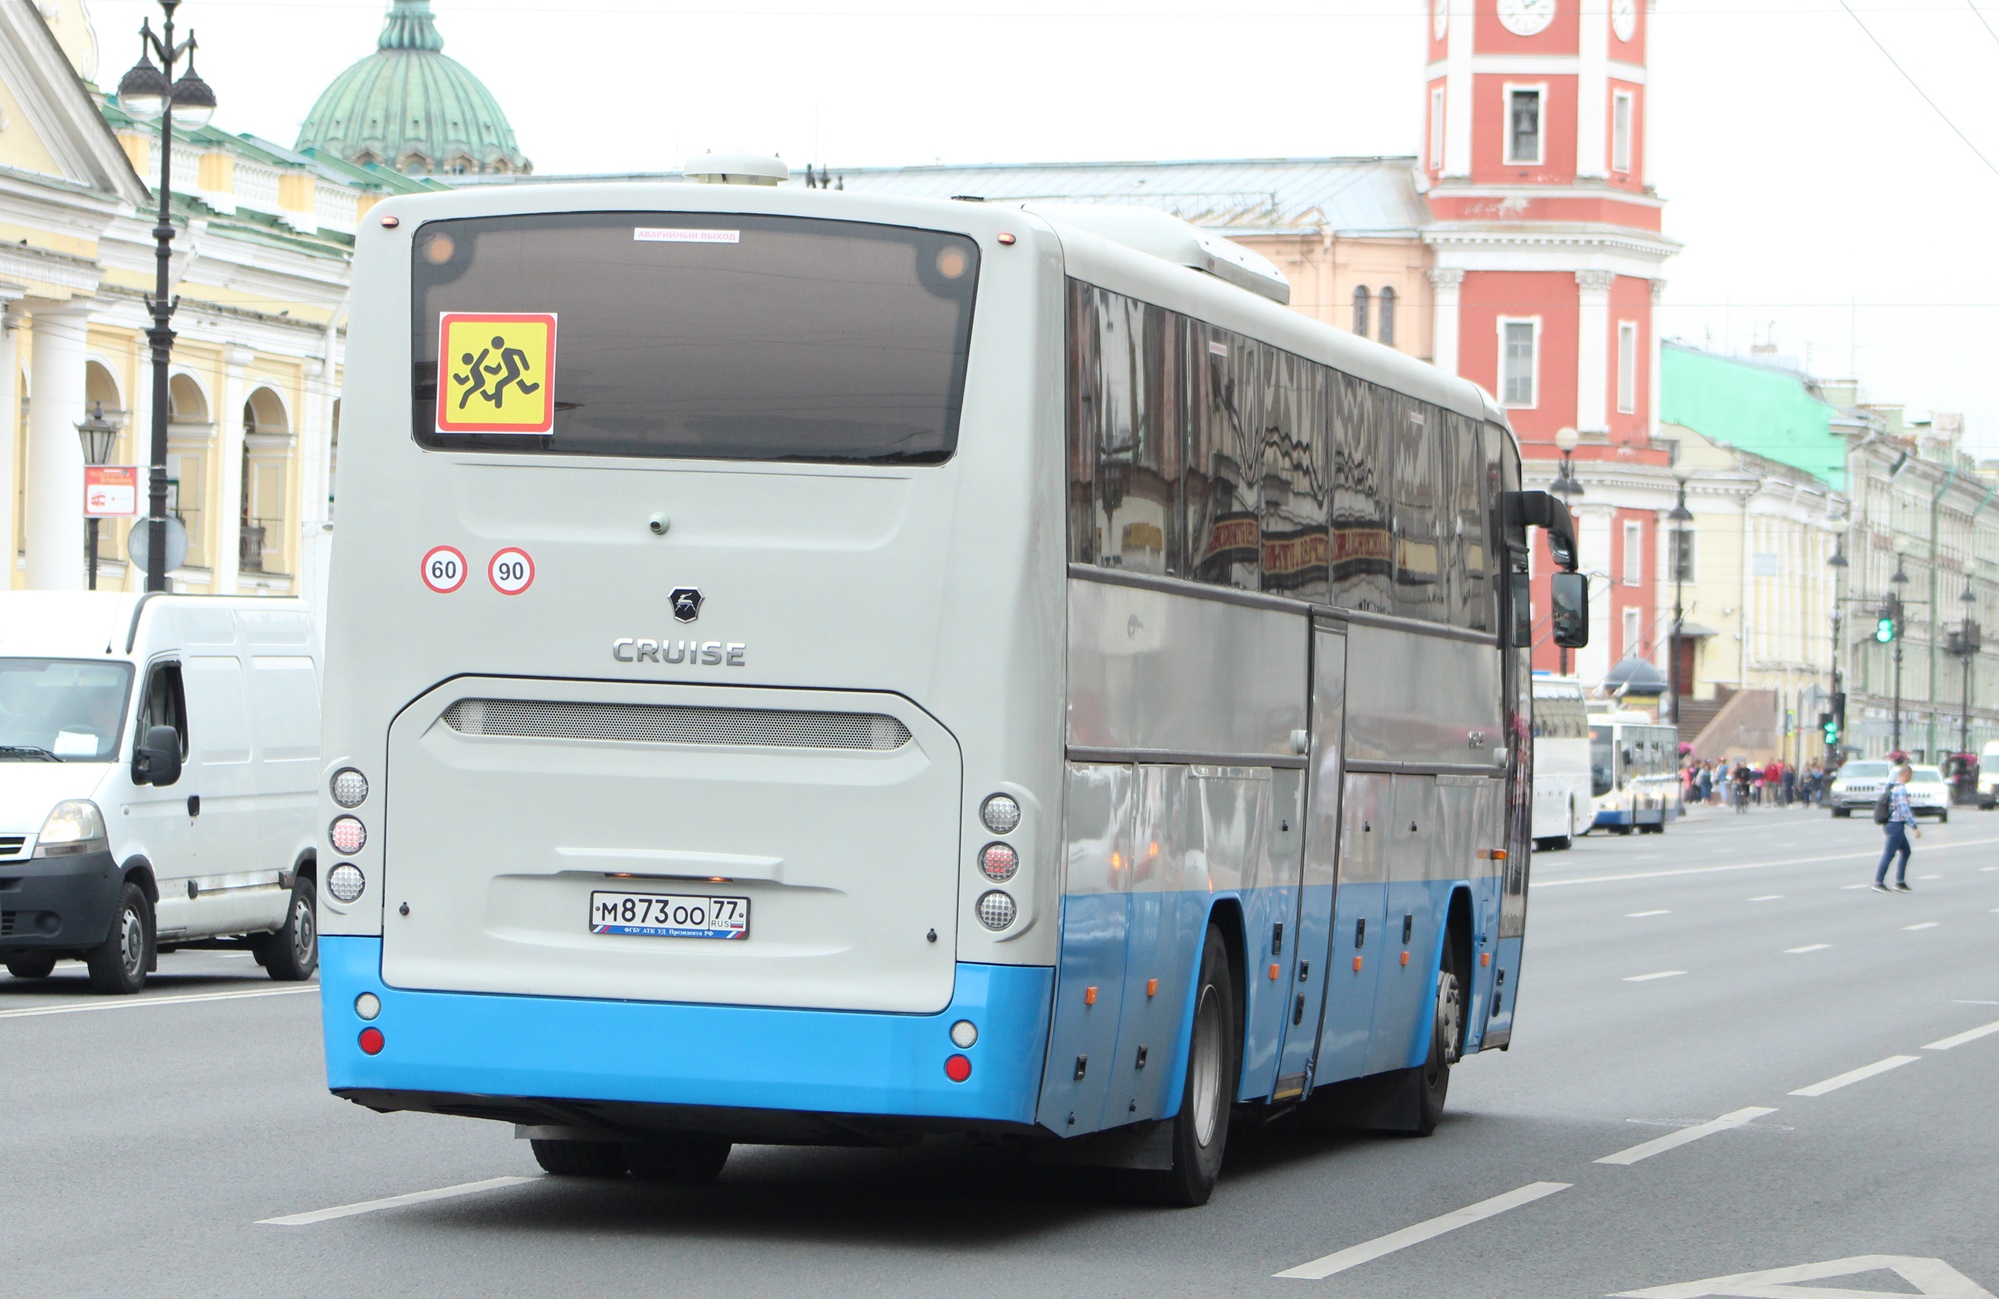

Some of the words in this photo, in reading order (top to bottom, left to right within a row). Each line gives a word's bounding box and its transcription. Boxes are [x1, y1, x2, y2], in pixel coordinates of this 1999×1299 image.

[638, 231, 698, 240] АВАРИЙНЫЙ
[701, 232, 736, 241] ВЫХОД
[431, 560, 457, 579] 60
[498, 561, 524, 581] 90
[612, 637, 747, 667] CRUISE
[713, 900, 738, 920] 77
[711, 920, 730, 928] RUS
